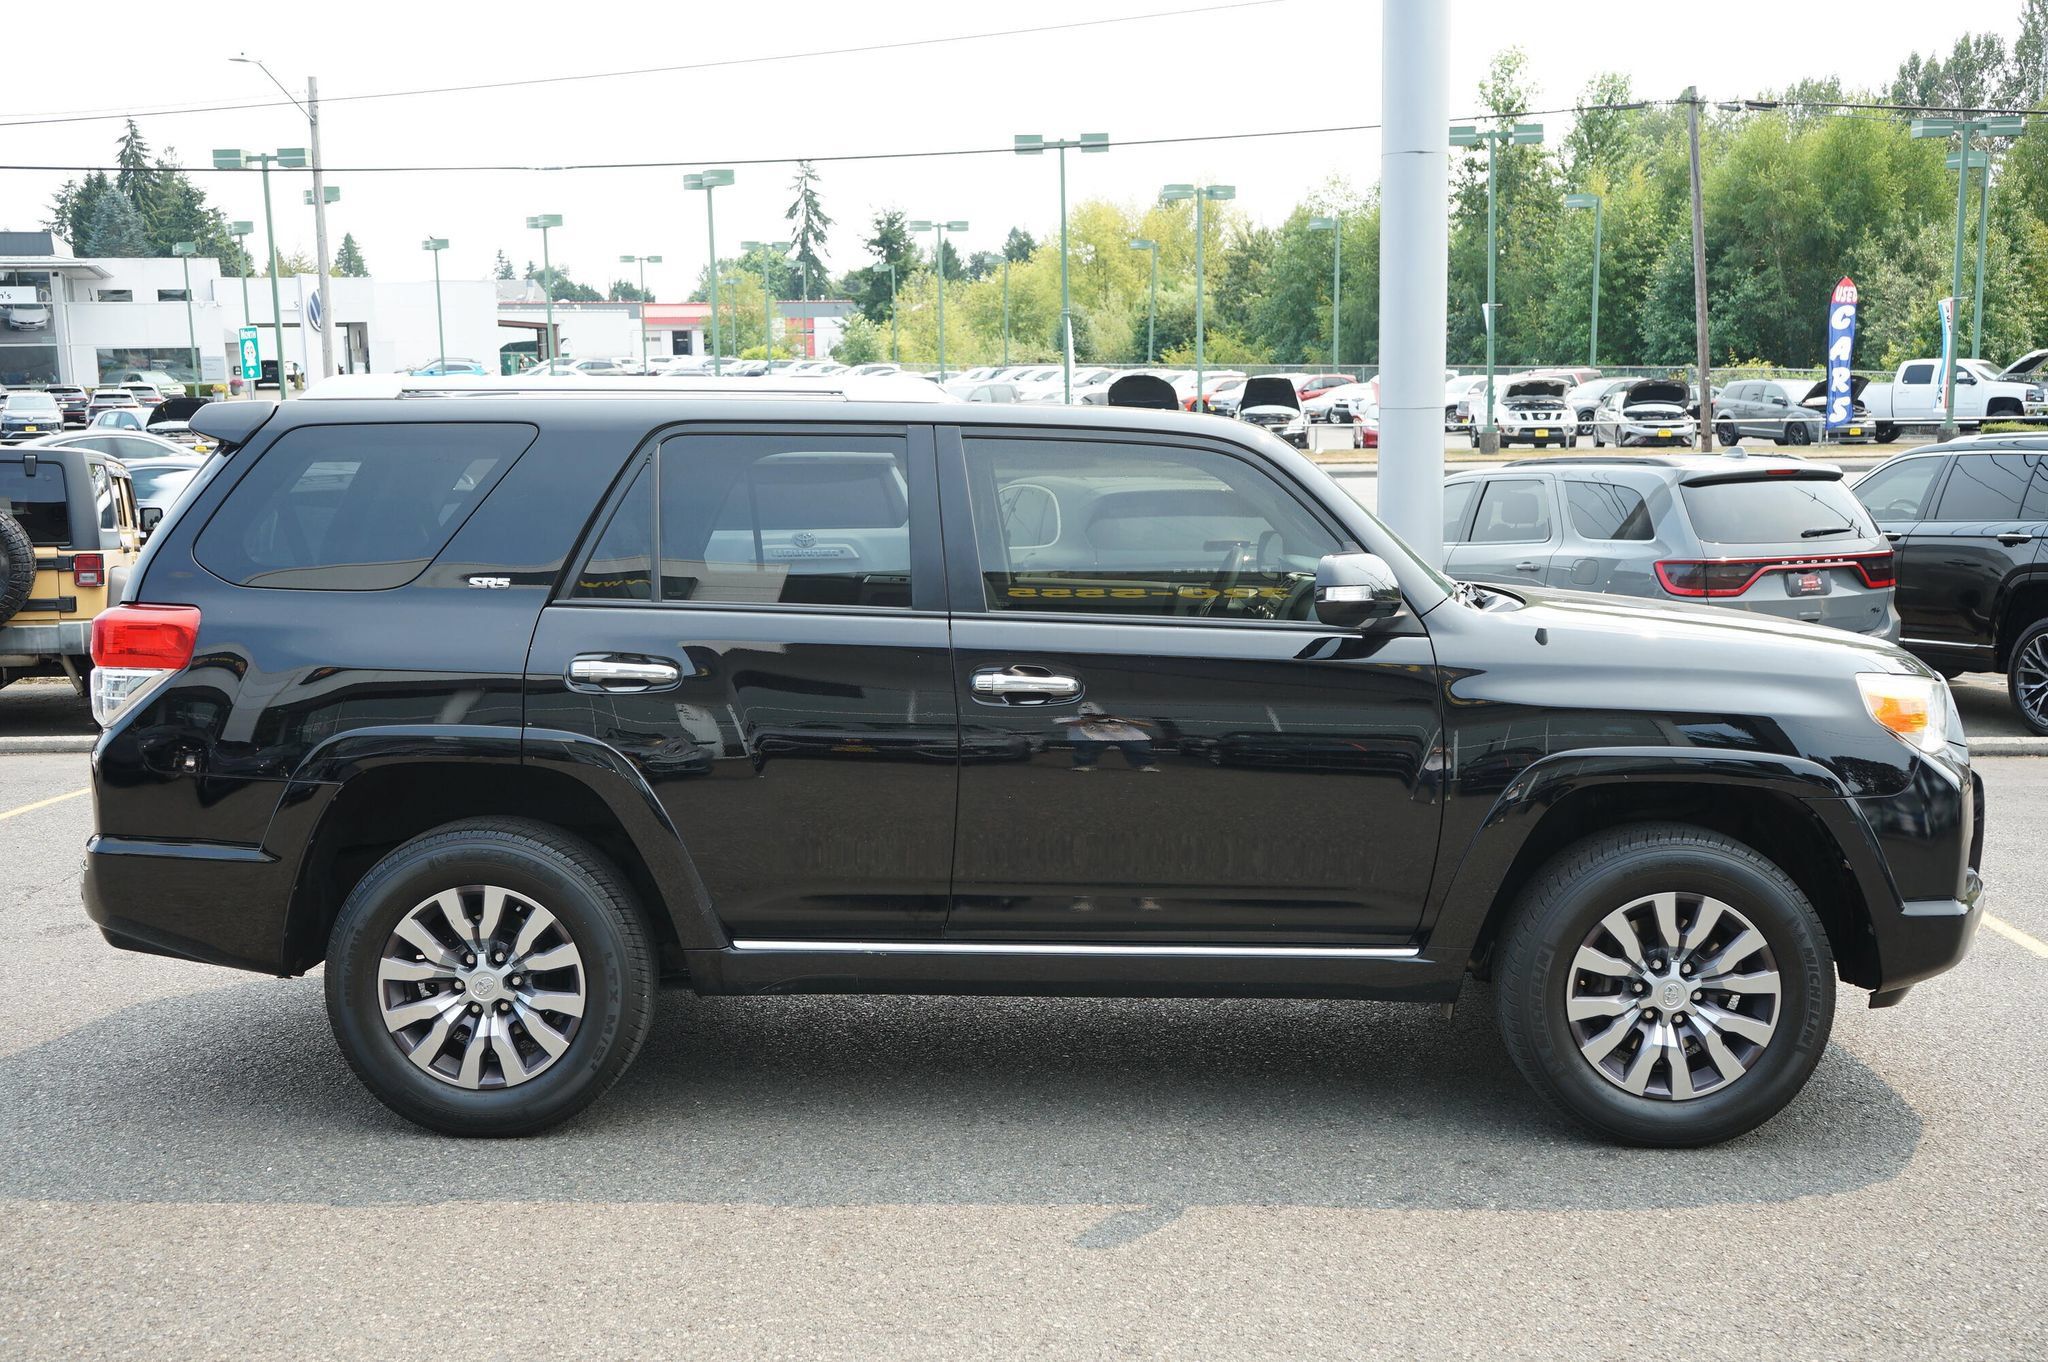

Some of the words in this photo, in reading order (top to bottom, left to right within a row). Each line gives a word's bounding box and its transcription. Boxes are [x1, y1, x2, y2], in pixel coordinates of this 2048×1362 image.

[1829, 304, 1856, 423] CARS
[468, 576, 511, 589] SR5
[1801, 947, 1823, 1049] MICHELIN
